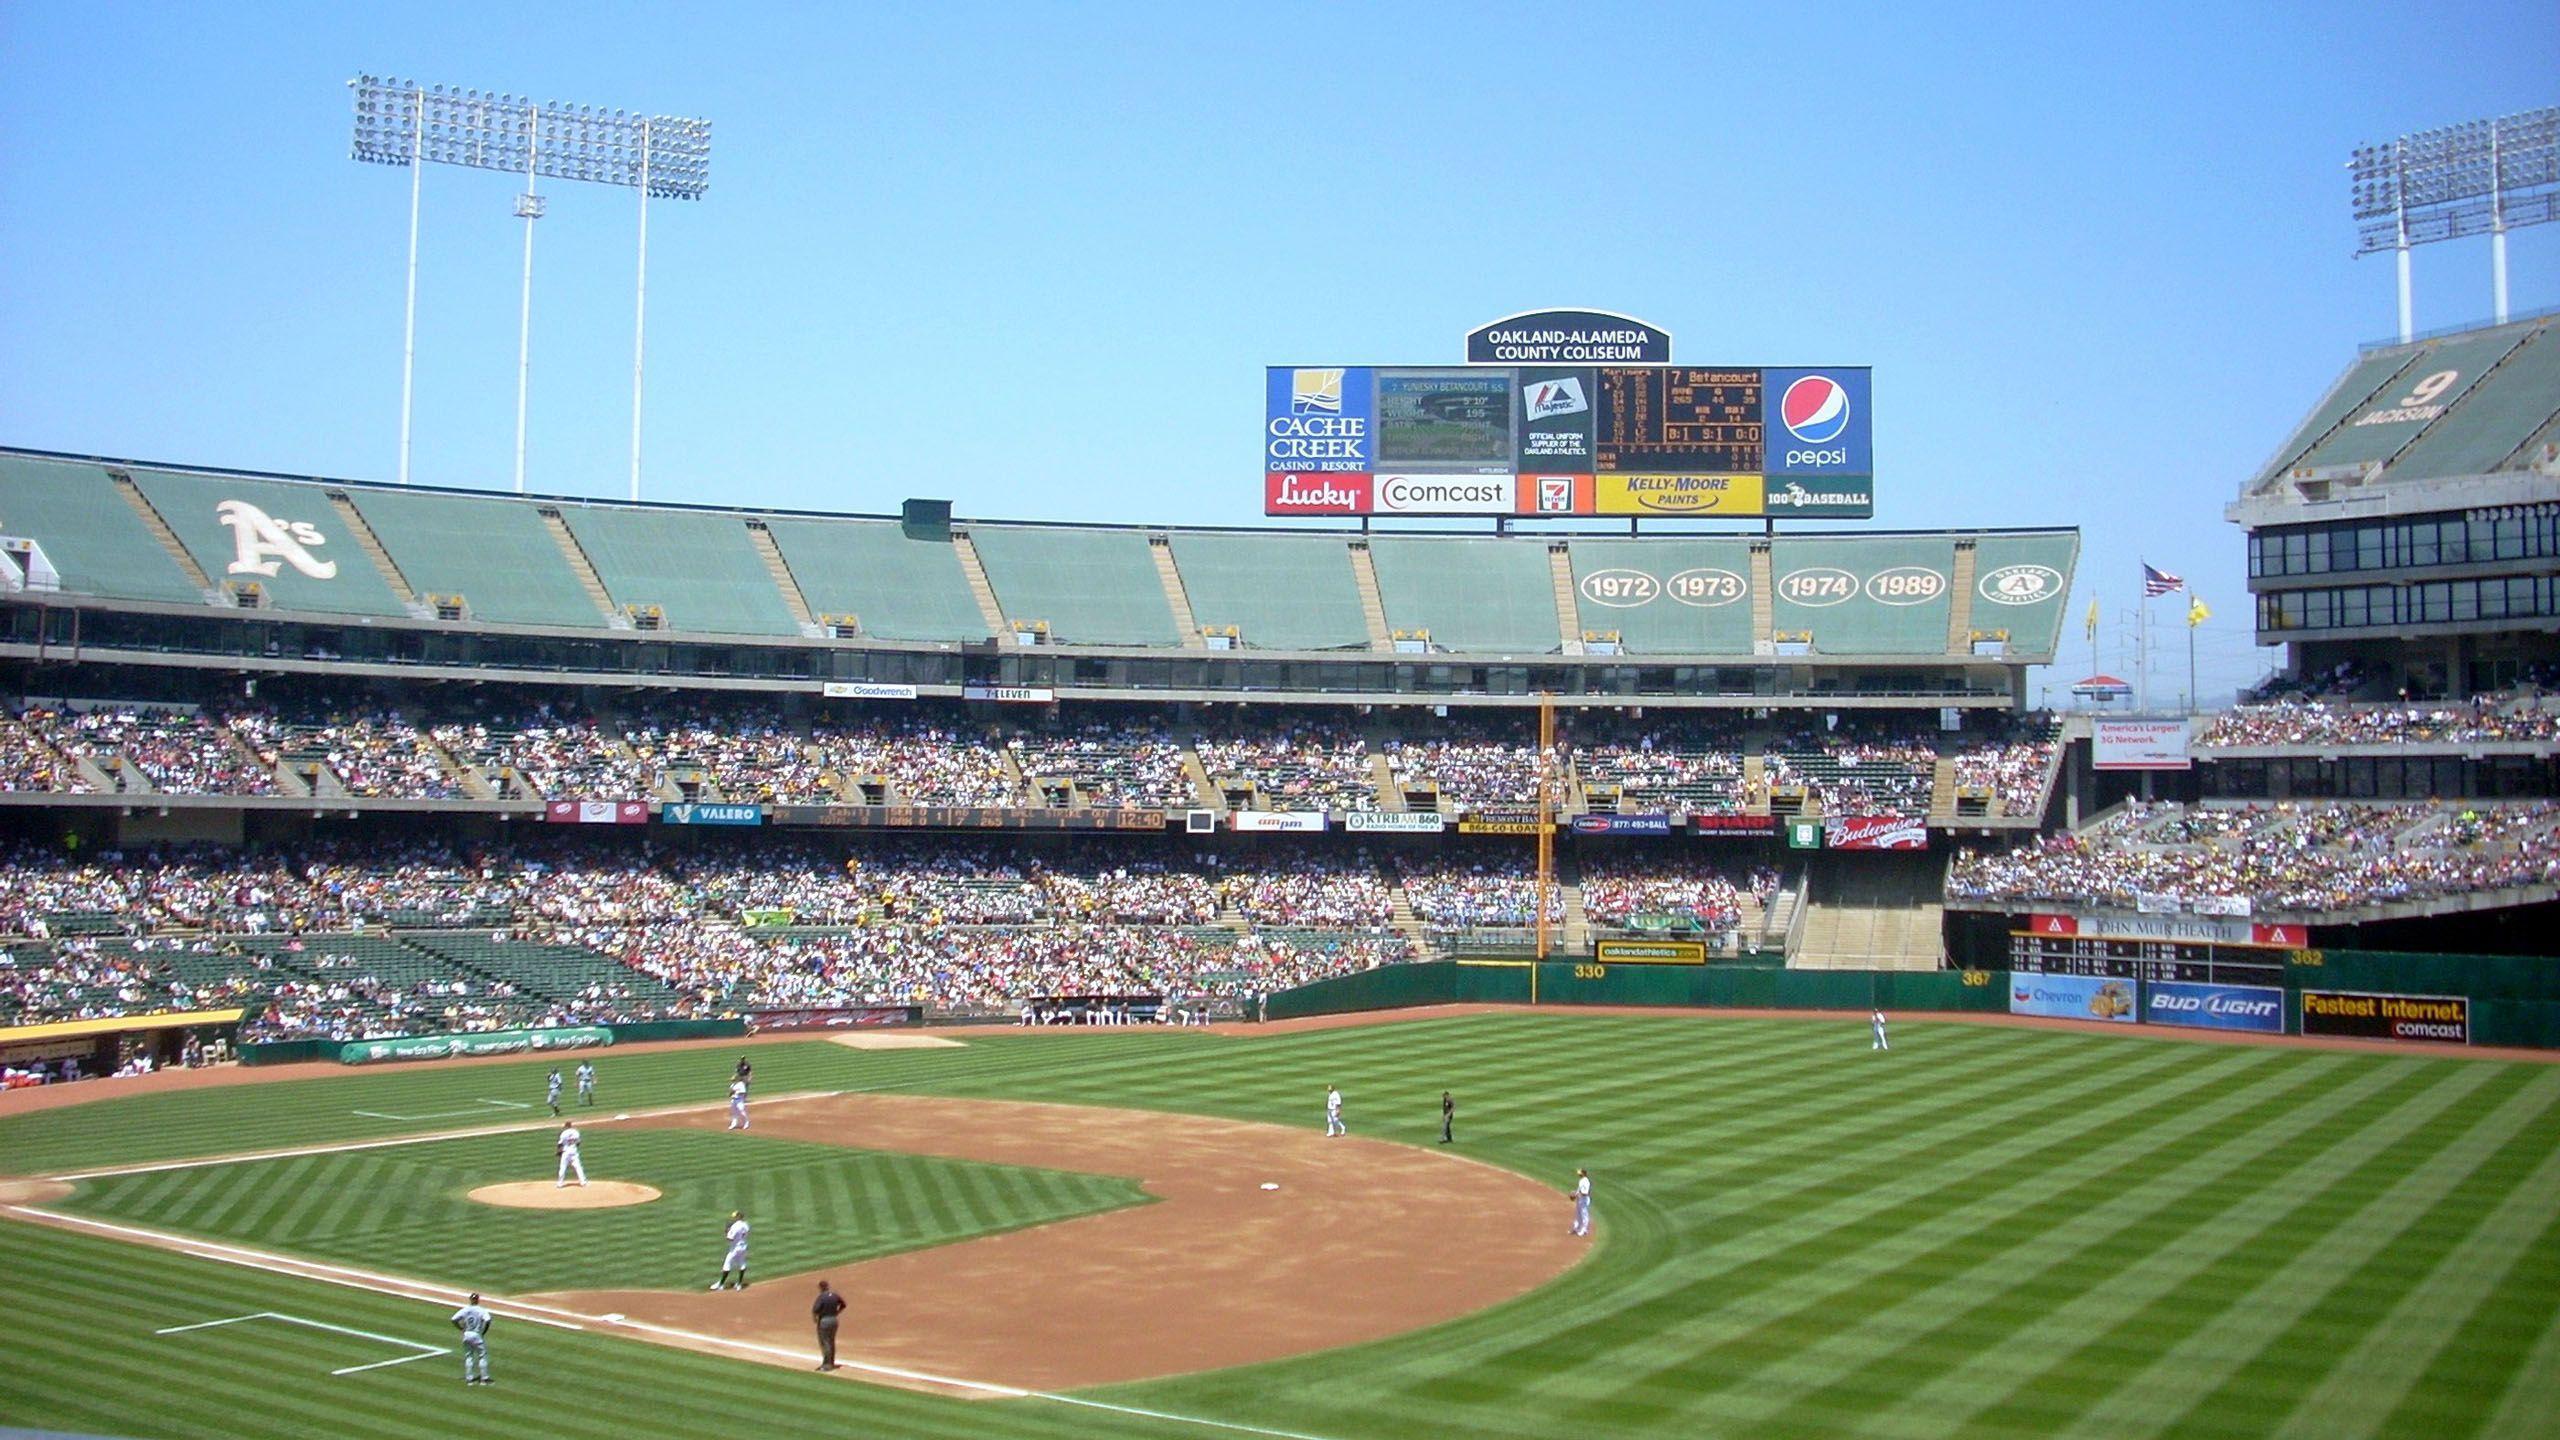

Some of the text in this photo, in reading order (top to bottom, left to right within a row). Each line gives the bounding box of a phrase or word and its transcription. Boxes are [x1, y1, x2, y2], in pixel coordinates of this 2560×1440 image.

[1488, 331, 1648, 344] OAKLAND-ALAMEDA
[1495, 346, 1641, 359] COUNTY COLISEUM
[1672, 371, 1758, 384] 7 Betancourt
[2400, 370, 2458, 407] 9
[2355, 404, 2444, 427] JACKSON
[1270, 417, 1365, 436] CACHE
[1270, 439, 1365, 458] CREEK
[1786, 447, 1846, 467] pepsi
[1270, 461, 1365, 471] CASINO RESORT
[1627, 477, 1730, 491] KELLY-MOORE
[1276, 475, 1356, 510] Lucky
[1657, 495, 1699, 504] PAINTS
[1804, 494, 1869, 504] BASEBALL
[1590, 578, 1650, 597] 1972
[1677, 578, 1737, 597] 1973
[1790, 577, 1848, 596] 1974
[1877, 576, 1937, 596] 1989
[853, 686, 912, 697] Goodwrench
[2101, 724, 2180, 733] America's Largest
[700, 808, 754, 820] VALERO
[1120, 813, 1160, 827] 12:40
[1367, 814, 1439, 824] KTRB AM 860
[1522, 814, 1541, 823] BAN
[1829, 817, 1923, 847] Budweiser
[2093, 918, 2232, 938] JOHN MUIR HEALTH
[2291, 951, 2323, 966] 362
[1575, 965, 1605, 978] 330
[1962, 971, 1990, 986] 367
[2033, 988, 2082, 1003] Chevron
[2151, 994, 2278, 1017] BUD LIGHT
[2305, 994, 2464, 1021] Fastest Internet.
[2395, 1022, 2463, 1039] comcast
